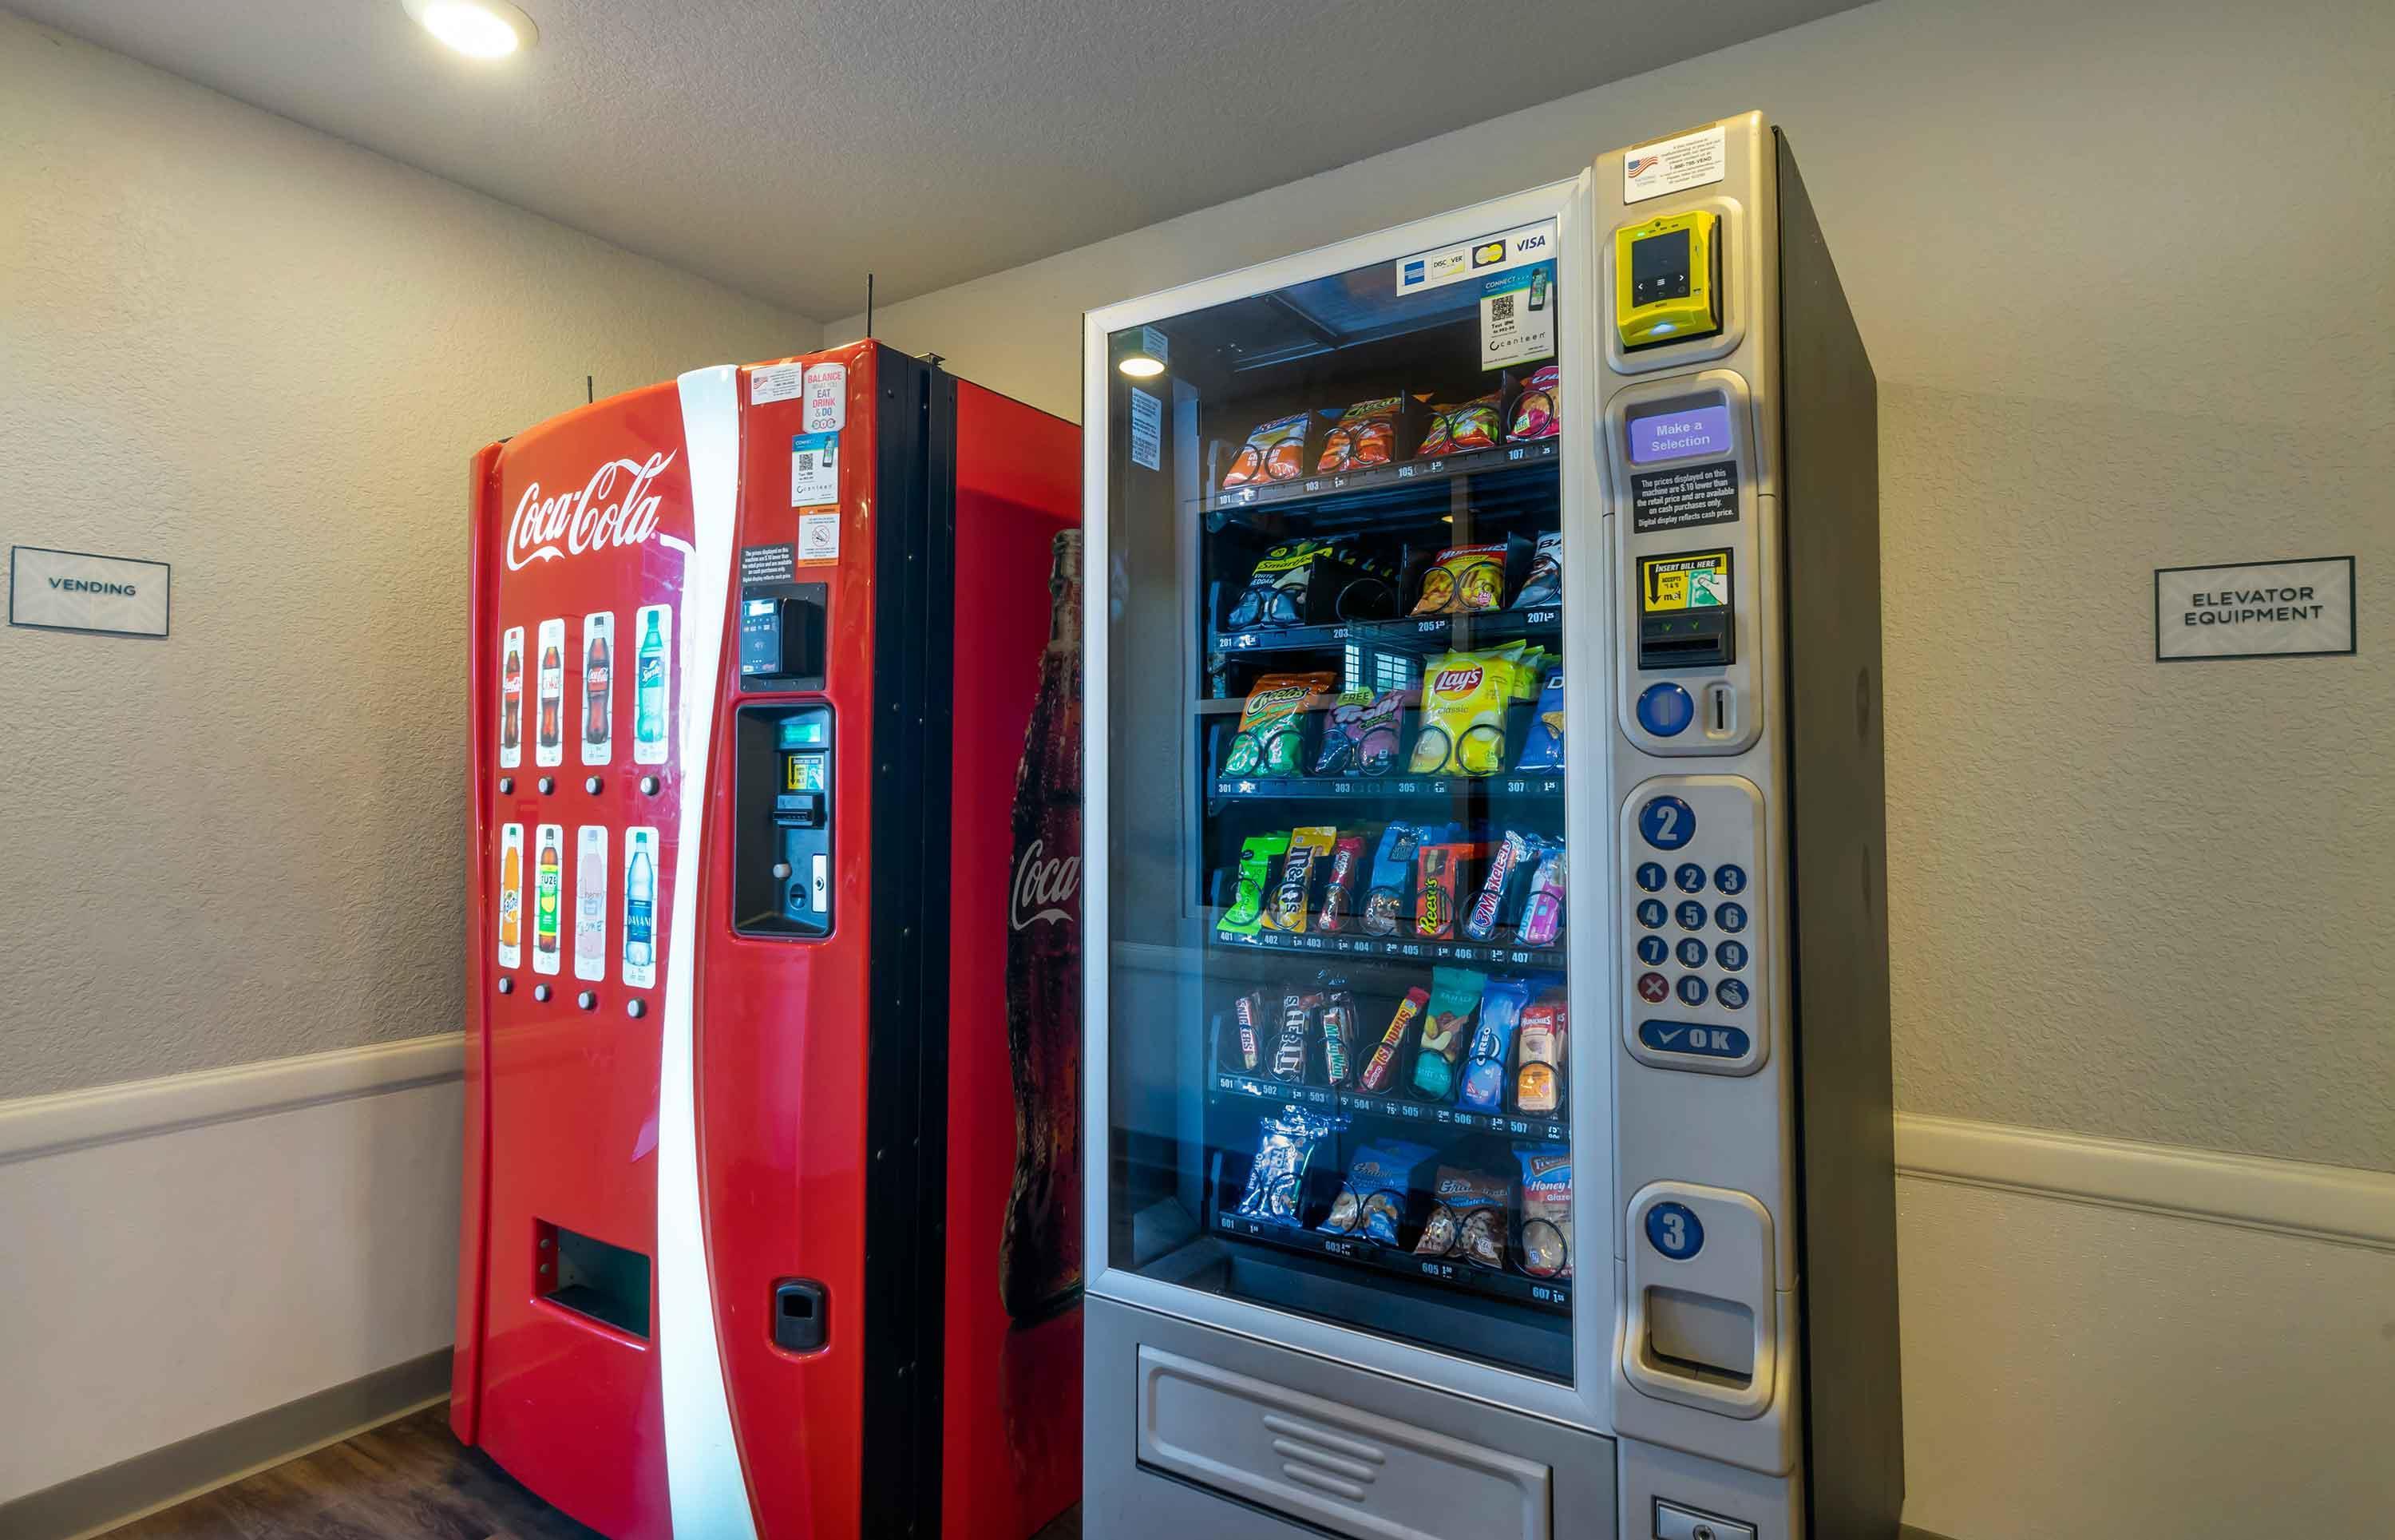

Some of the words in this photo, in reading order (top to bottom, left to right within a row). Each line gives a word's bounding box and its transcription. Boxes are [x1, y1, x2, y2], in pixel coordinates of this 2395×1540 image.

[1517, 235, 1546, 252] VISA
[1433, 255, 1463, 268] DISCVER
[1486, 275, 1515, 288] CONNECT
[1501, 331, 1546, 346] canteen
[807, 371, 842, 384] BALANCE
[817, 389, 830, 398] EAT
[812, 398, 836, 408] DRINK
[821, 407, 832, 416] DO
[1657, 422, 1691, 437] Make
[1693, 422, 1703, 431] a
[1651, 435, 1711, 452] Selection
[1508, 449, 1524, 461] 107
[1398, 465, 1413, 477] 105
[1654, 477, 1673, 489] prices
[1674, 472, 1704, 484] displayed
[1714, 469, 1726, 477] this
[1304, 481, 1320, 492] 103
[1641, 488, 1669, 497] machine
[1695, 481, 1713, 490] lower
[1219, 494, 1231, 505] 101
[1648, 497, 1664, 505] retail
[1665, 495, 1680, 505] price
[1706, 486, 1736, 497] available
[506, 447, 678, 572] Coca-Cola
[1658, 505, 1673, 513] cash
[1673, 501, 1707, 513] purchases
[1707, 497, 1723, 508] only.
[1638, 517, 1657, 528] Digital
[1657, 515, 1677, 525] display
[1678, 513, 1700, 522] reflects
[1701, 510, 1716, 519] cash
[1716, 509, 1735, 518] price.
[1655, 564, 1680, 572] INSERT
[1680, 561, 1696, 571] BILL
[1696, 560, 1716, 568] HERE
[48, 577, 137, 596] VENDING
[2192, 586, 2314, 608] ELEVATOR
[1527, 612, 1544, 623] 207
[2184, 604, 2324, 627] EQUIPMENT
[1418, 621, 1435, 632] 205
[1333, 628, 1348, 639] 203
[1219, 638, 1232, 647] 201
[642, 666, 663, 687] Sprite
[1436, 668, 1482, 692] Lay's
[1247, 686, 1311, 716] Cheetos
[1342, 691, 1370, 702] FREE
[1437, 706, 1469, 715] Classic
[1218, 783, 1232, 793] 301
[1335, 782, 1350, 793] 303
[1399, 782, 1415, 793] 305
[1507, 782, 1525, 792] 307
[1656, 806, 1678, 841] 2
[540, 874, 557, 886] FUZE
[1646, 868, 1657, 887] 1
[1685, 869, 1697, 889] 2
[1724, 870, 1738, 890] 3
[1419, 876, 1438, 935] Reese's
[1645, 904, 1659, 924] 4
[1685, 906, 1699, 926] 5
[1724, 908, 1739, 928] 6
[1220, 932, 1233, 941] 401
[1264, 935, 1278, 944] 402
[1306, 937, 1321, 948] 403
[1354, 942, 1369, 952] 404
[1402, 945, 1419, 956] 405
[1648, 940, 1660, 960] 7
[1686, 943, 1700, 963] 8
[1725, 945, 1740, 965] 9
[1455, 948, 1472, 959] 406
[1512, 952, 1528, 963] 407
[1686, 980, 1700, 1000] 0
[1688, 1028, 1731, 1051] OK
[1477, 1027, 1491, 1067] OREO
[1220, 1079, 1233, 1089] 501
[1263, 1085, 1277, 1095] 502
[1309, 1093, 1325, 1103] 503
[1354, 1099, 1369, 1110] 504
[1402, 1106, 1419, 1116] 505
[1455, 1114, 1472, 1125] 506
[1510, 1122, 1527, 1133] 507
[1531, 1180, 1566, 1193] Honey
[1221, 1217, 1234, 1229] 601
[1662, 1212, 1685, 1250] 3
[1325, 1241, 1340, 1253] 603
[1422, 1263, 1439, 1275] 605
[1532, 1286, 1550, 1300] 607
